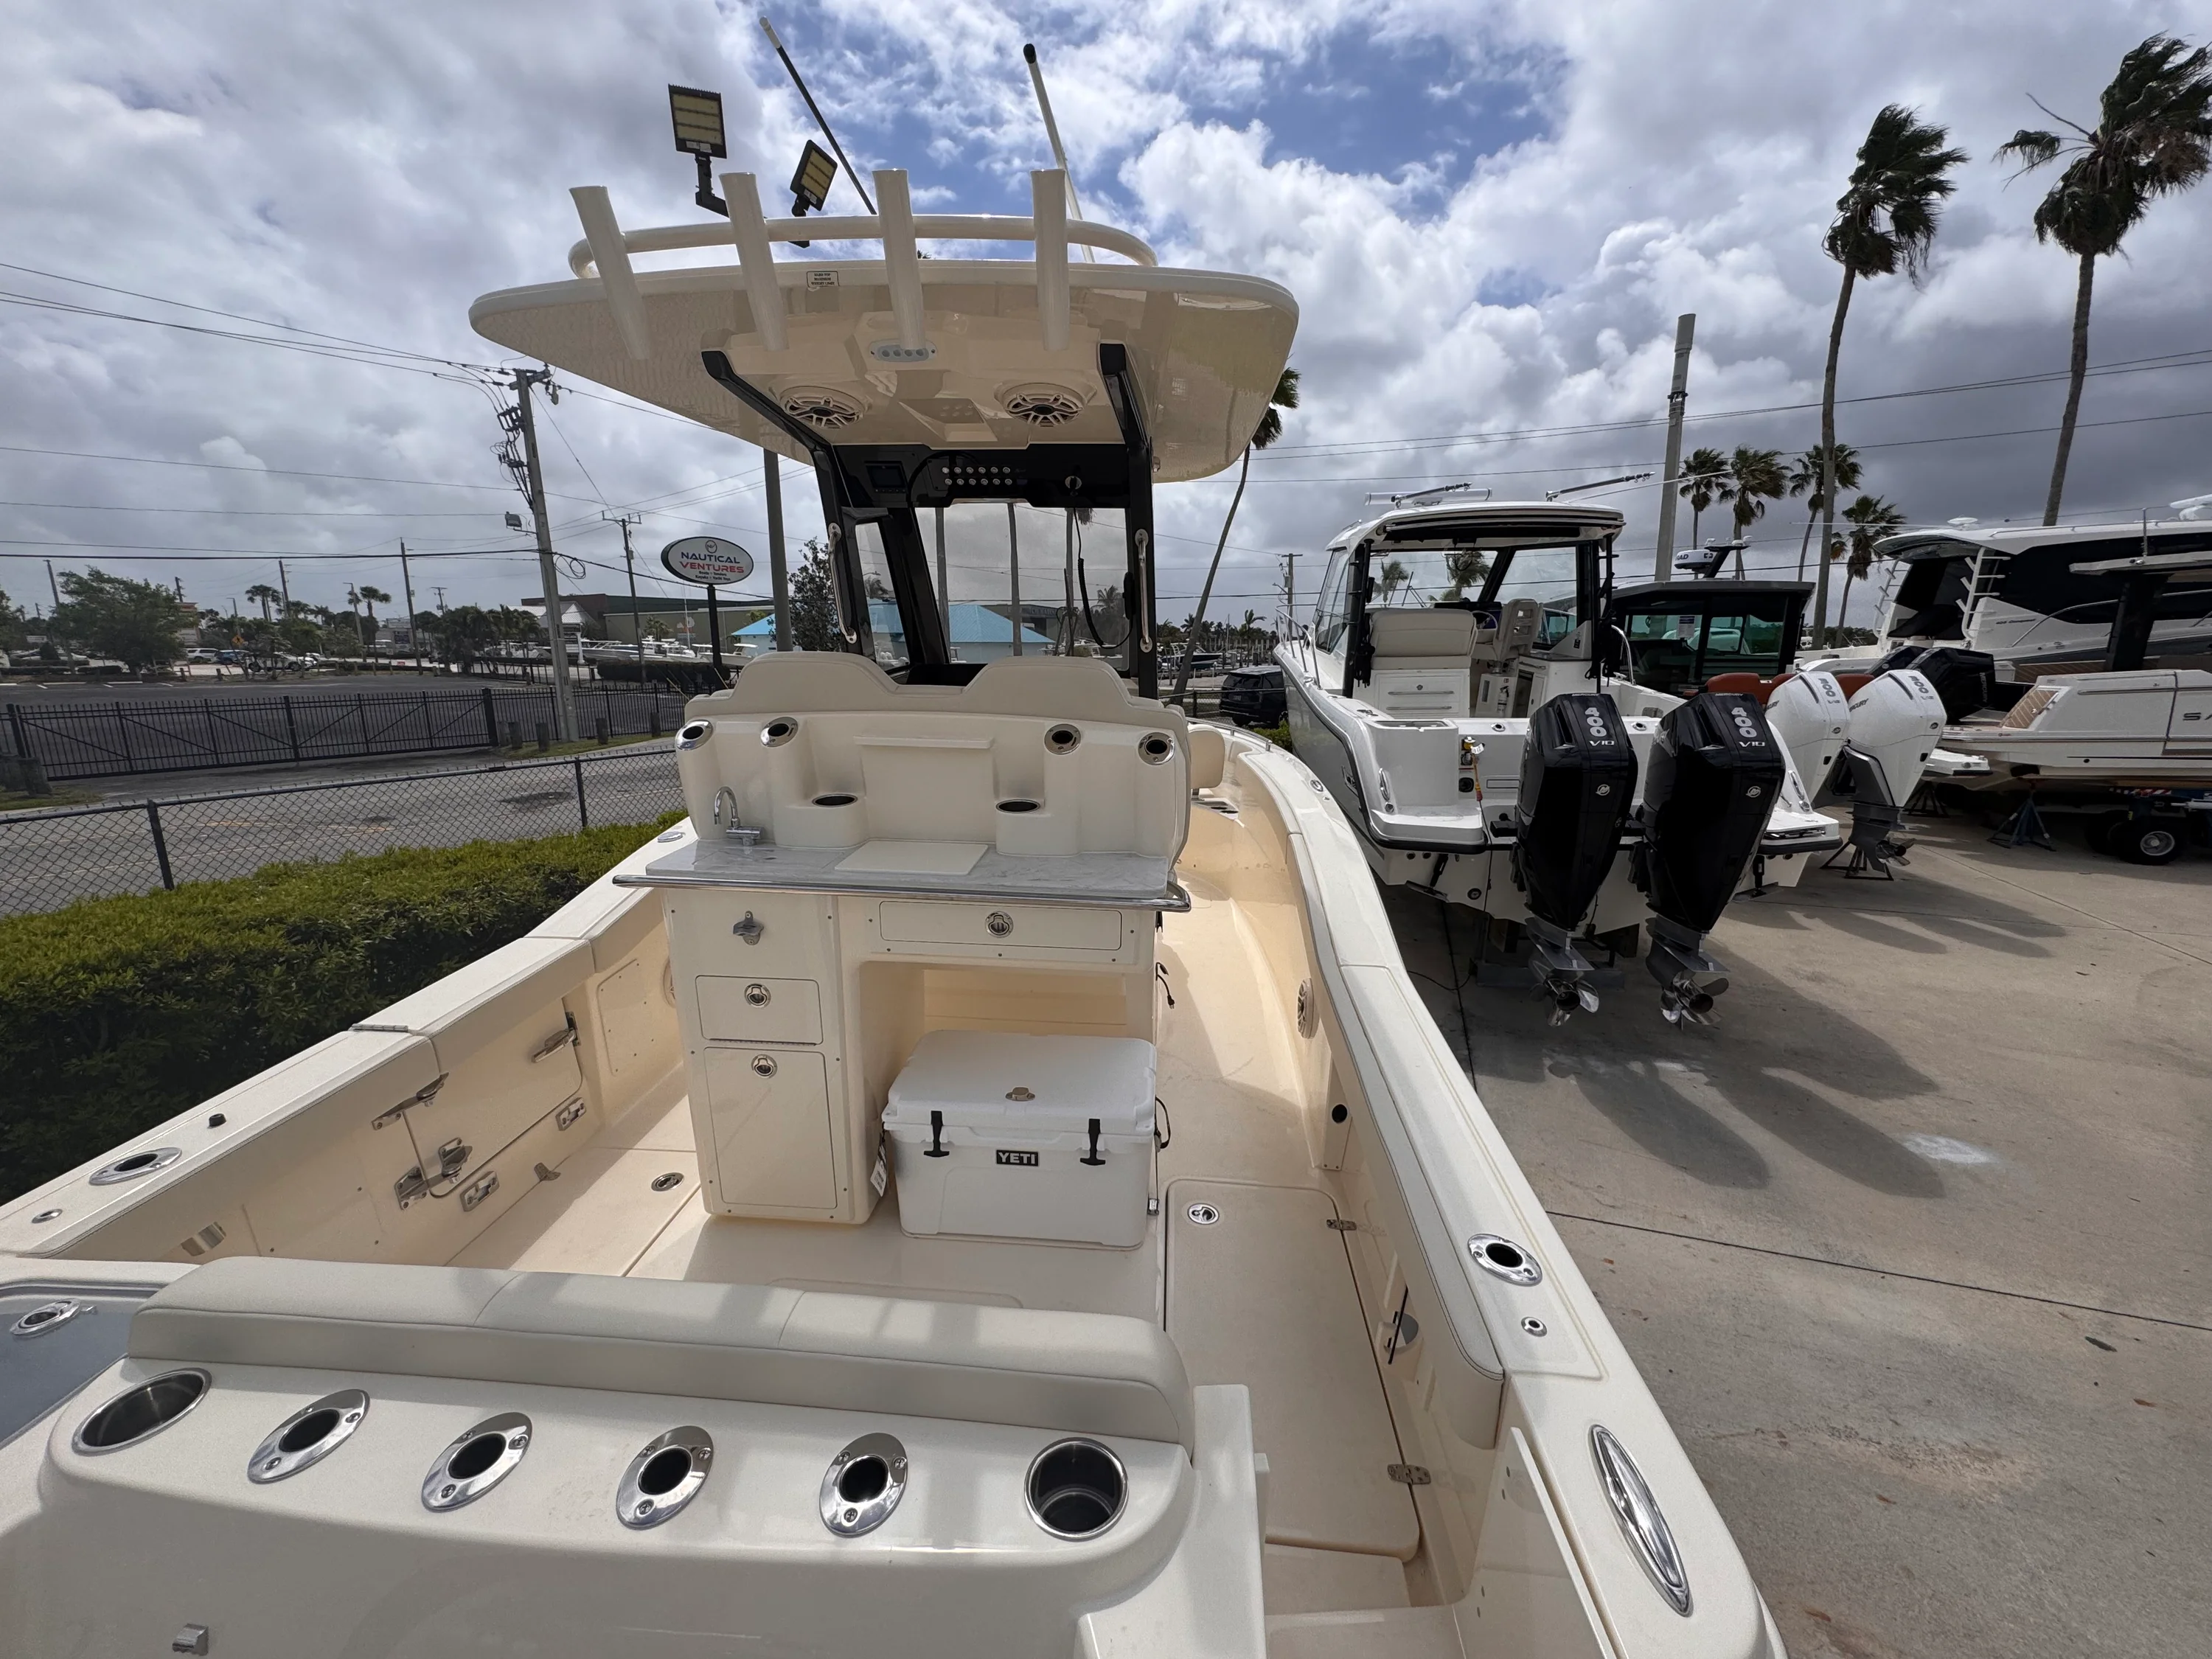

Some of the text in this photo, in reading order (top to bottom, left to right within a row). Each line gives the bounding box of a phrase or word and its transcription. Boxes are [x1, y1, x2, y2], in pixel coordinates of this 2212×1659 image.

[681, 552, 740, 564] NAUTICAL
[679, 560, 744, 574] VENTURES
[1585, 707, 1607, 737] 400
[1731, 707, 1758, 738] 400
[998, 1152, 1035, 1164] YETI
